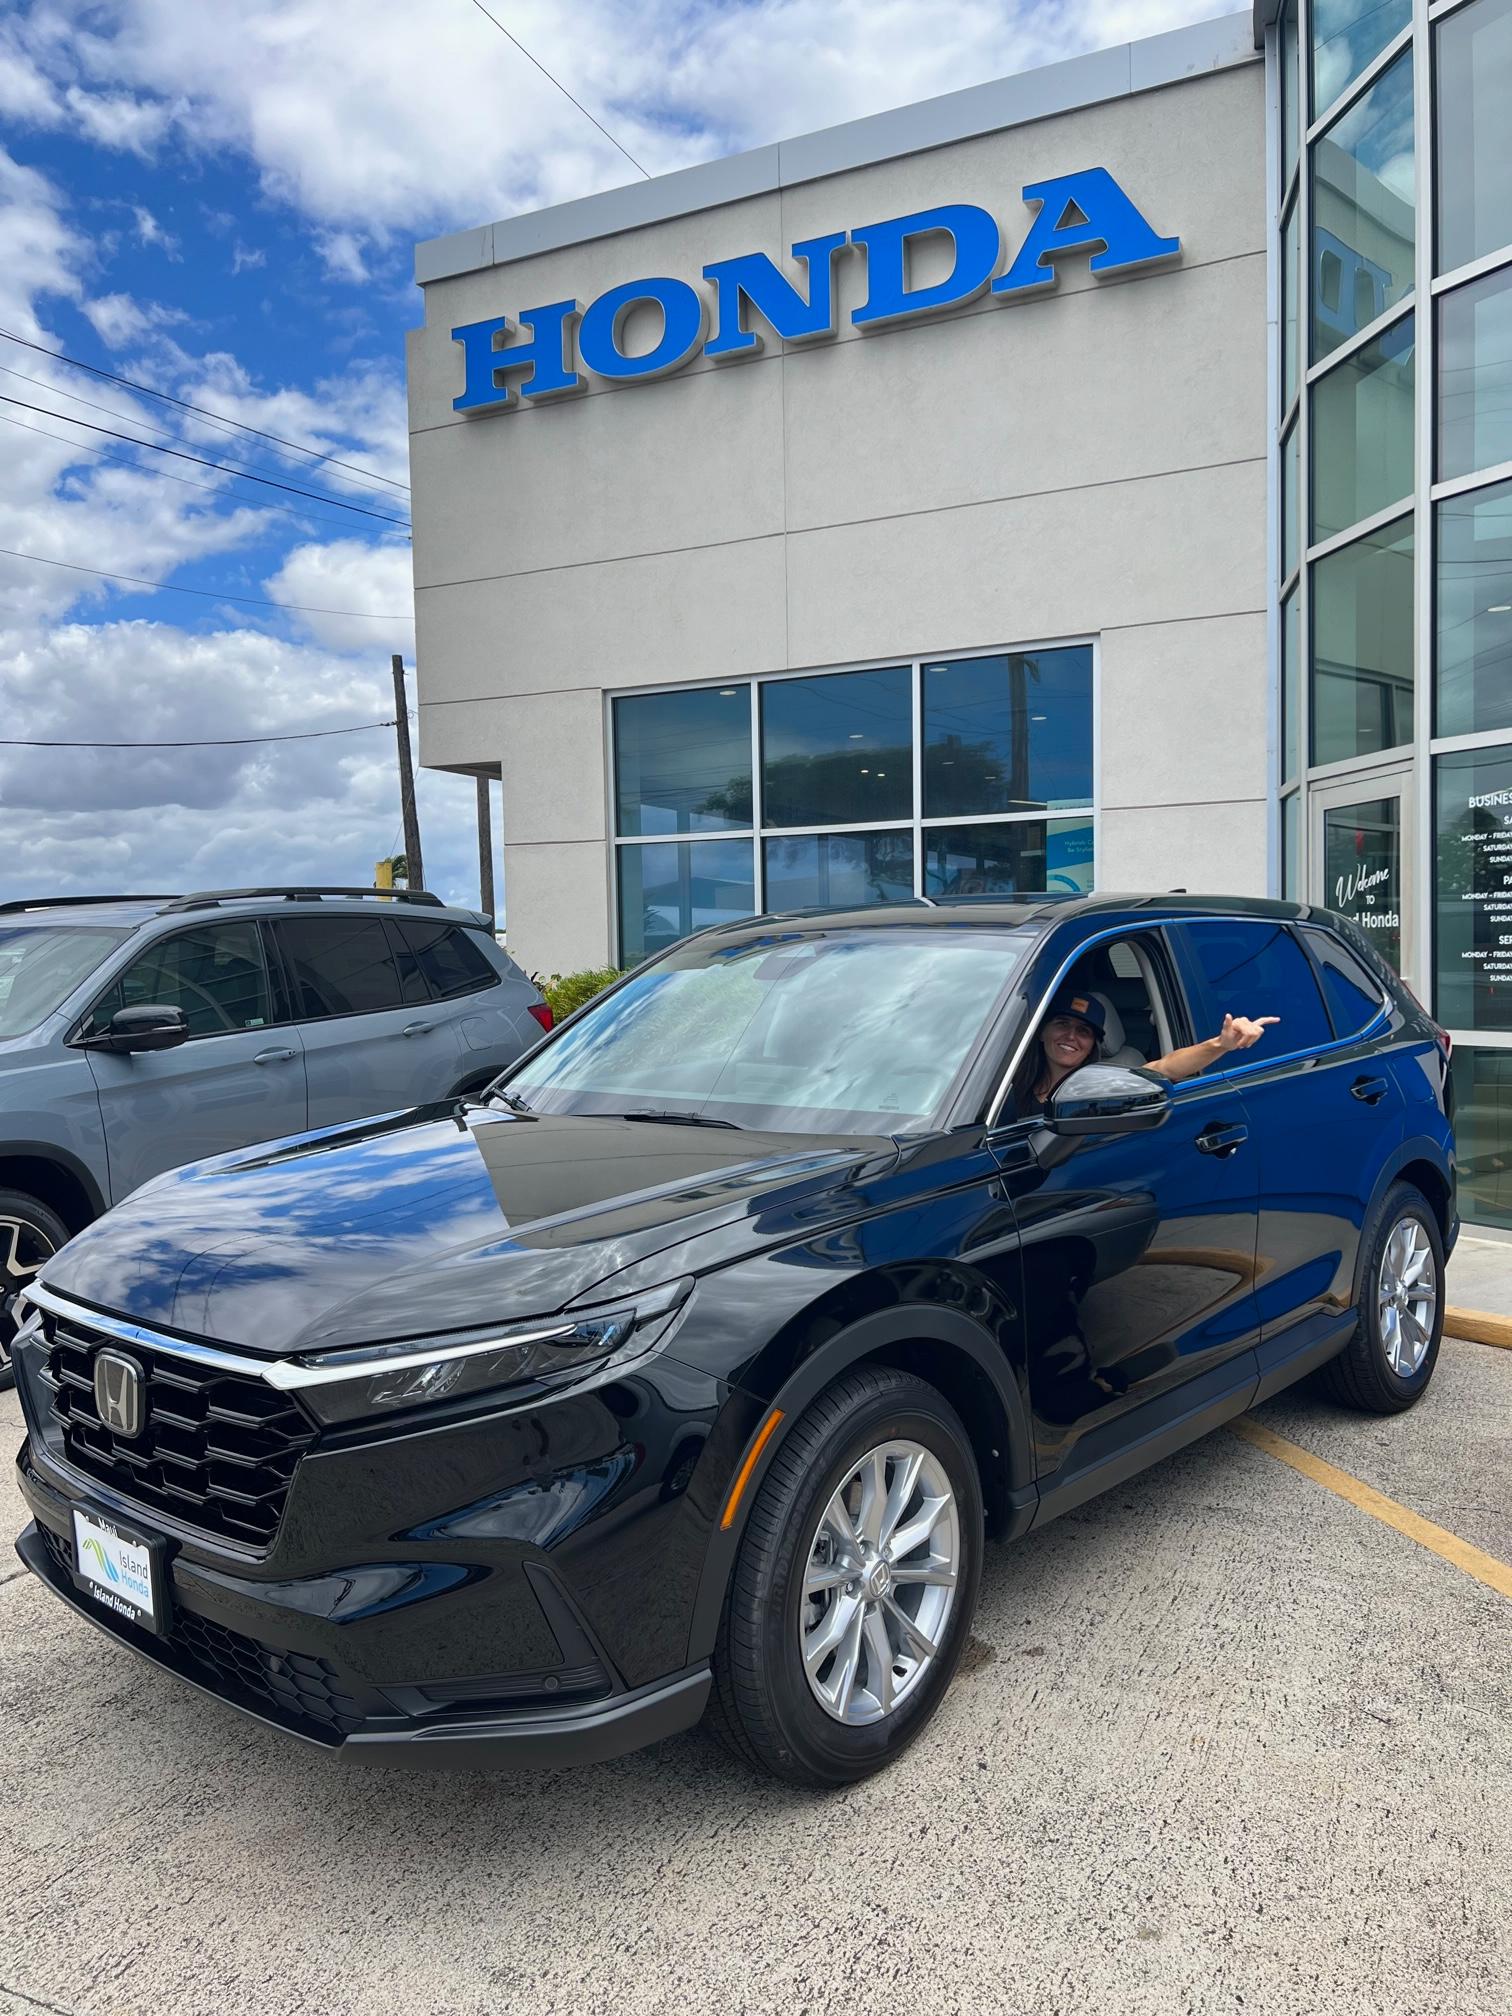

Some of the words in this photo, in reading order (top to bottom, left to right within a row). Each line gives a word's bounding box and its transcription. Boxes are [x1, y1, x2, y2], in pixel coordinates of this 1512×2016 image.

[451, 166, 1182, 415] HONDA
[1461, 833, 1488, 841] MONDAY
[1335, 863, 1390, 908] Welcome
[1461, 892, 1488, 900] MONDAY
[1365, 895, 1376, 905] TO
[1362, 910, 1399, 928] Honda
[1461, 951, 1488, 959] MONDAY
[119, 1550, 148, 1579] Island
[121, 1571, 149, 1598] Honda
[93, 1585, 114, 1608] Island
[114, 1597, 136, 1621] Honda
